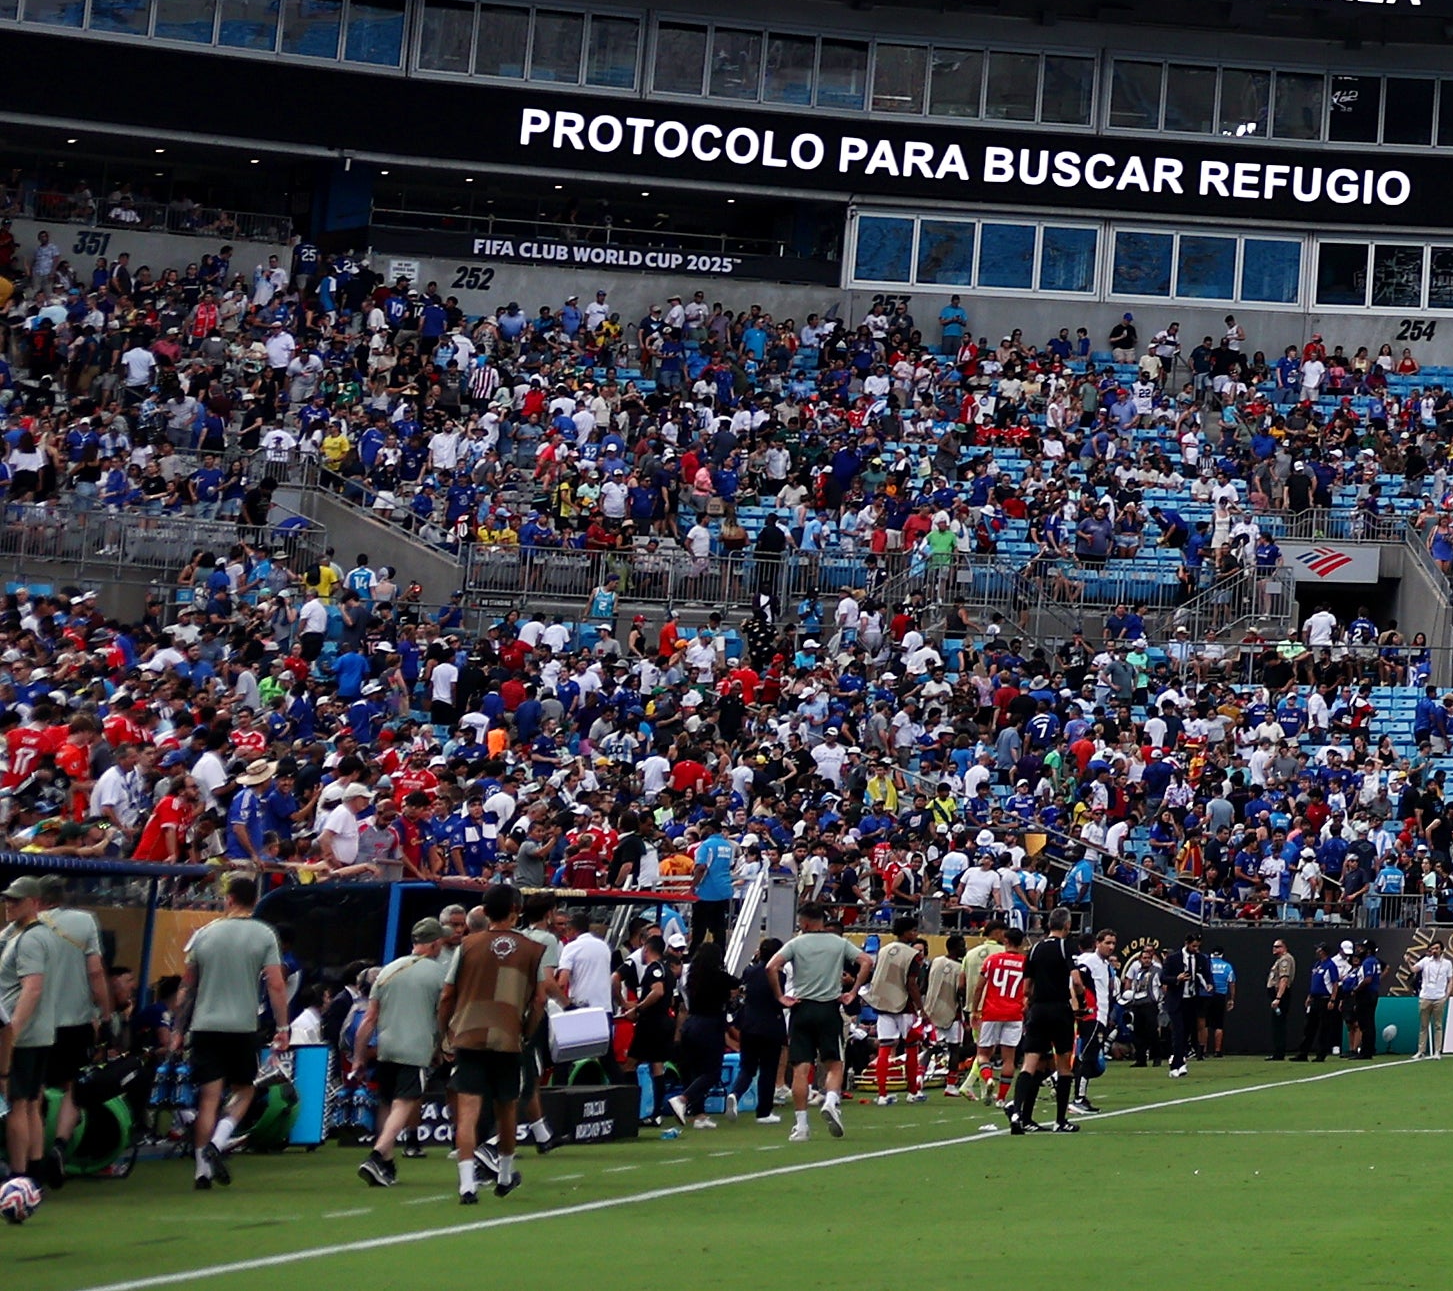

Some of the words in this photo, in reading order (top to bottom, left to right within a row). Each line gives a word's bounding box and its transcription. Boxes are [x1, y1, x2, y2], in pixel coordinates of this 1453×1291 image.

[521, 109, 824, 169] PROTOCOLO
[839, 137, 969, 180] PARA
[984, 147, 1183, 193] BUSCAR
[1200, 161, 1410, 205] REFUGIO
[73, 232, 111, 256] 351
[474, 239, 514, 256] FIFA
[519, 242, 568, 260] CLUB
[573, 247, 642, 265] WORLD
[645, 253, 682, 268] CUP
[451, 266, 494, 290] 252
[1396, 320, 1436, 341] 254
[1139, 388, 1151, 397] 22
[1121, 936, 1160, 958] WORLD
[993, 969, 1024, 998] 47
